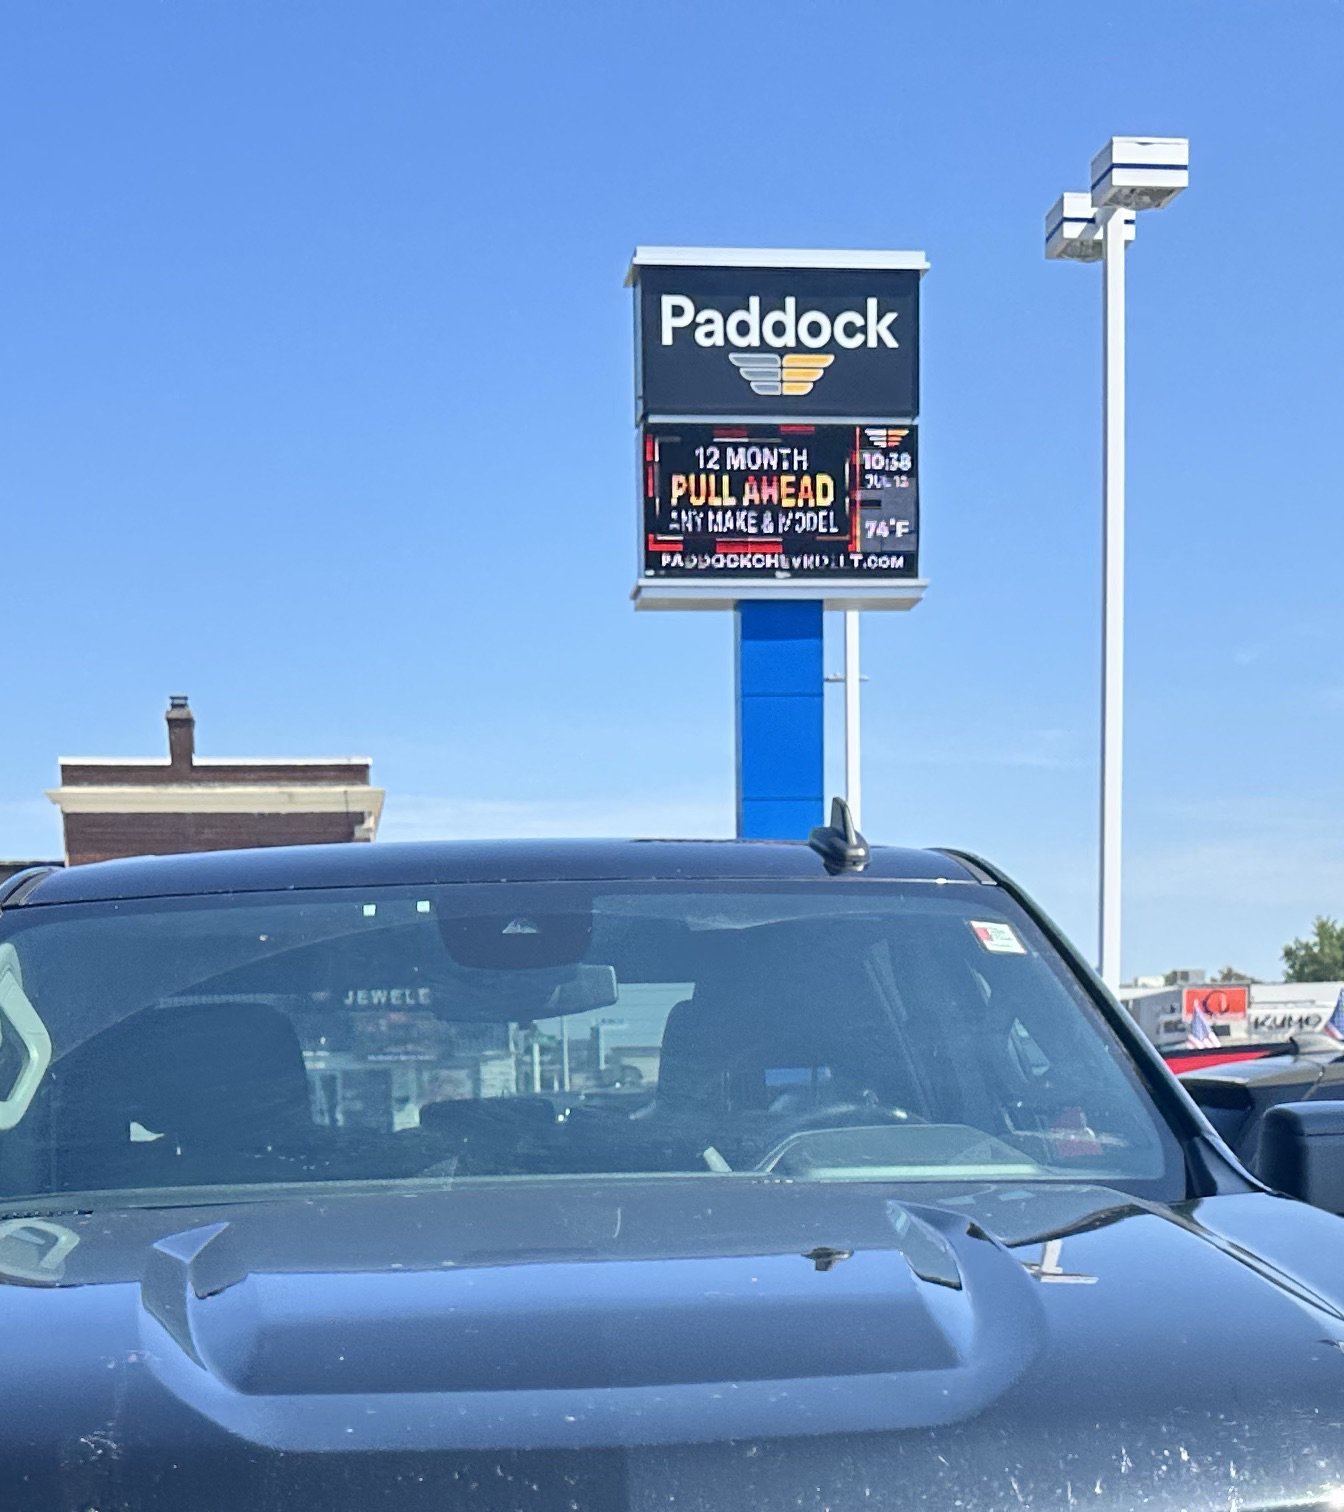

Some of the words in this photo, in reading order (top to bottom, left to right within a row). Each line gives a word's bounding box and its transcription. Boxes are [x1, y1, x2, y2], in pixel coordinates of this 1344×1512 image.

[660, 294, 899, 349] Paddock
[694, 446, 720, 470] 12
[726, 446, 808, 471] MONTH
[671, 473, 737, 506] PULL
[742, 473, 835, 508] AHEAD
[707, 509, 758, 533] MAKE
[777, 510, 839, 533] MODEL
